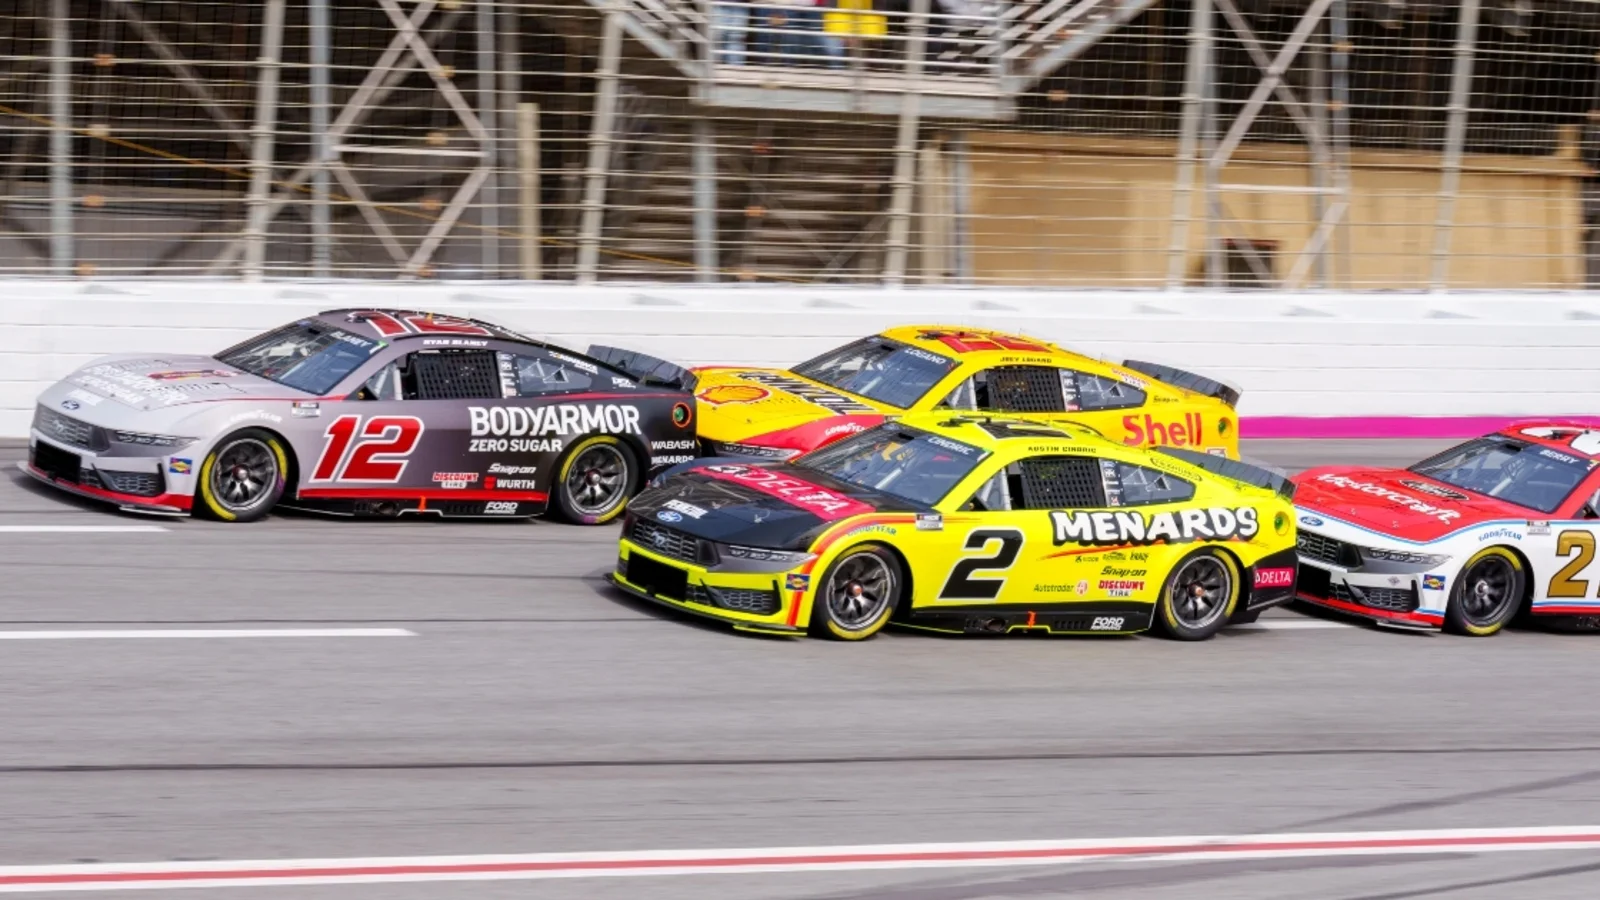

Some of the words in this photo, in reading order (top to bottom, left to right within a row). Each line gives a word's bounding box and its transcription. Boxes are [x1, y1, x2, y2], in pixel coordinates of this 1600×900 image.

[904, 347, 947, 366] LOGANO
[1022, 356, 1052, 364] LOGANO
[468, 404, 642, 436] BODYARMOR
[825, 422, 866, 436] GOODYE
[1122, 412, 1202, 446] Shell
[308, 414, 424, 483] 12
[468, 439, 507, 452] ZERO
[509, 438, 563, 452] SUGAR
[650, 440, 695, 449] WABASH
[928, 436, 975, 455] CINDRIC
[1539, 449, 1580, 465] BERRY
[487, 463, 536, 475] Snap-on
[485, 501, 518, 510] FORD
[1050, 507, 1259, 546] MENARDS
[1478, 528, 1522, 541] GOODYEAR
[937, 526, 1026, 602] 2
[1547, 529, 1600, 598] 2
[1101, 565, 1147, 577] Snap-on
[1260, 571, 1292, 584] DELTA
[1098, 580, 1145, 591] DISCOUNT
[1092, 616, 1125, 627] FORD
